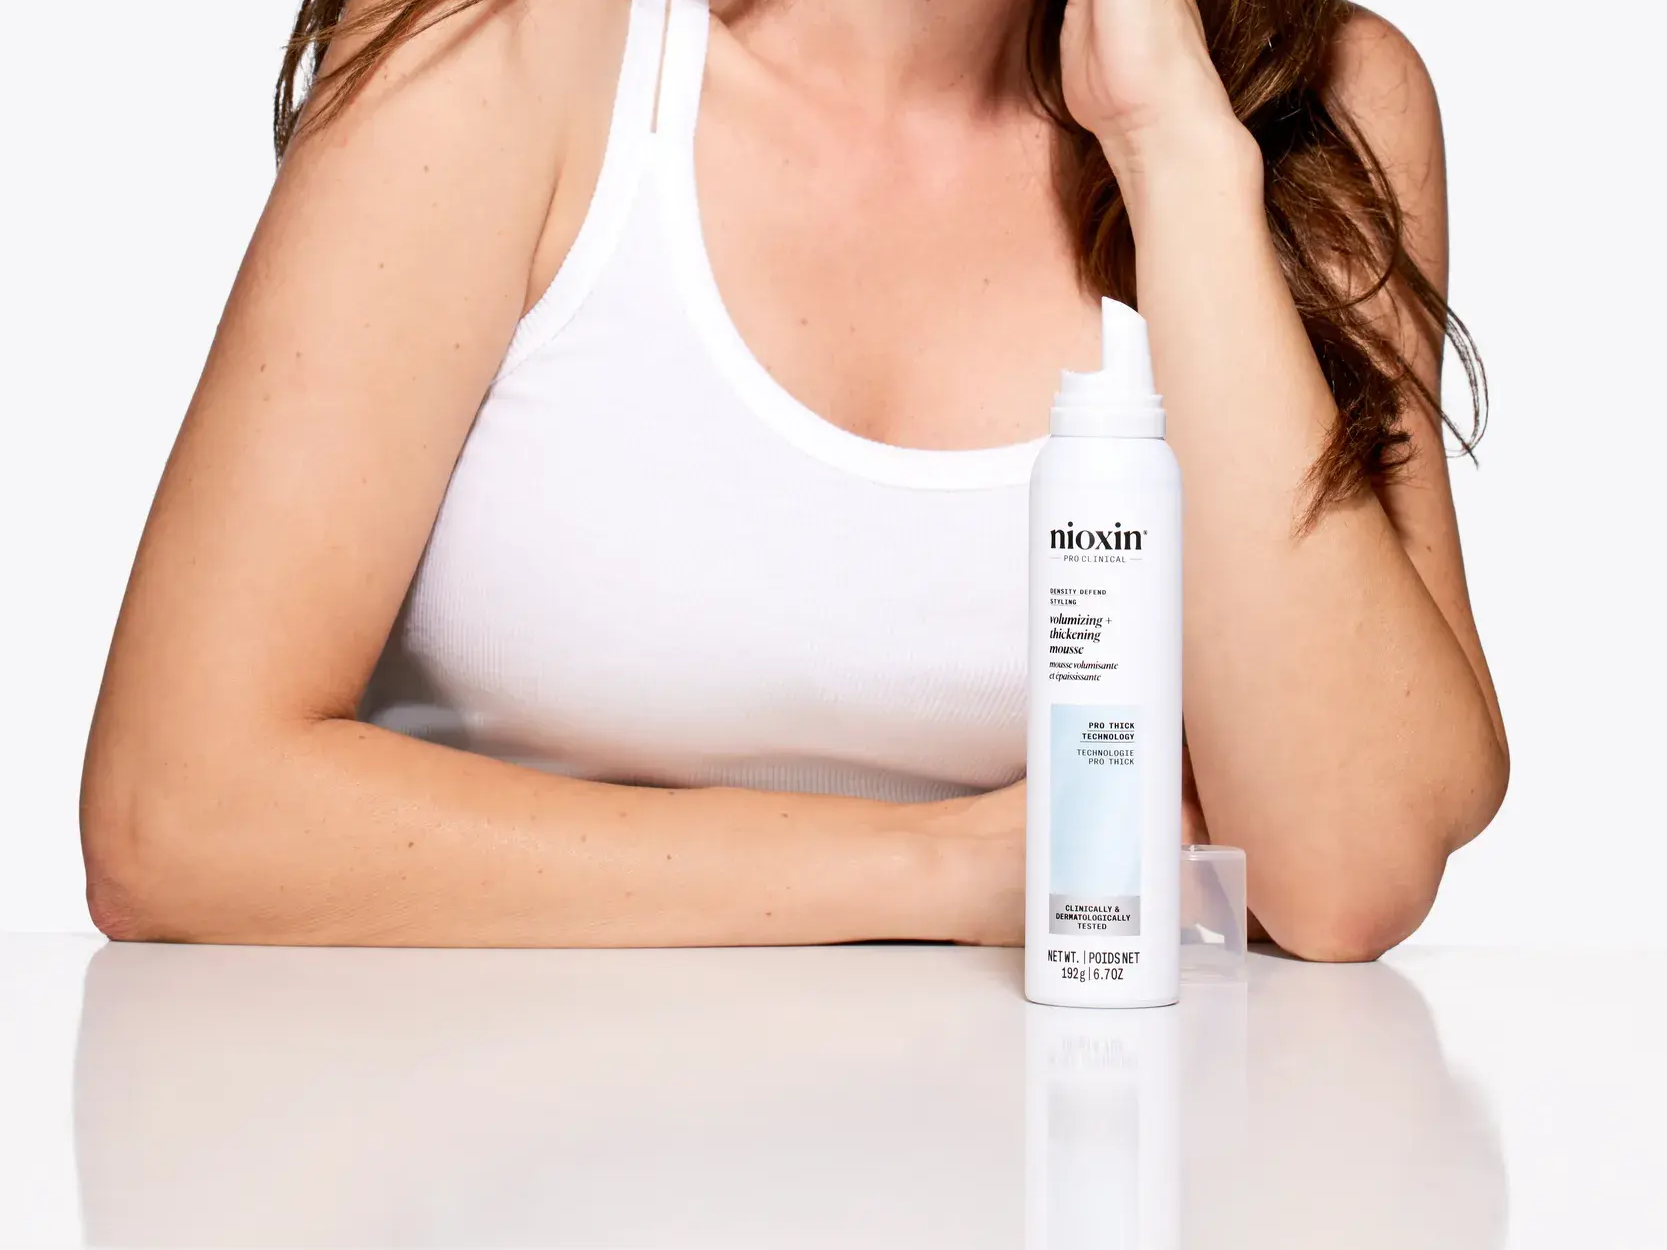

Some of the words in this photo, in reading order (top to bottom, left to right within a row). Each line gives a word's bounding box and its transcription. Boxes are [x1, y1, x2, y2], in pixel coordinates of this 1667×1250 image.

[1050, 521, 1142, 551] nioxin
[1063, 555, 1080, 563] PRO
[1081, 555, 1127, 564] CLINICAL
[1049, 613, 1103, 628] volumizing
[1049, 628, 1101, 643] thickening
[1049, 644, 1085, 655] mousse
[1049, 661, 1073, 669] mousse
[1073, 660, 1119, 670] volumisante
[1109, 722, 1135, 730] THICK
[1076, 749, 1135, 757] TECHNOLOGIE
[1109, 758, 1135, 766] THICK
[1065, 904, 1113, 913] CLINICALLY
[1055, 913, 1131, 921] DERMATOLOGICALLY
[1047, 950, 1063, 962] NET
[1064, 951, 1080, 964] WT.
[1088, 952, 1121, 964] POIDS
[1122, 952, 1140, 964] NET
